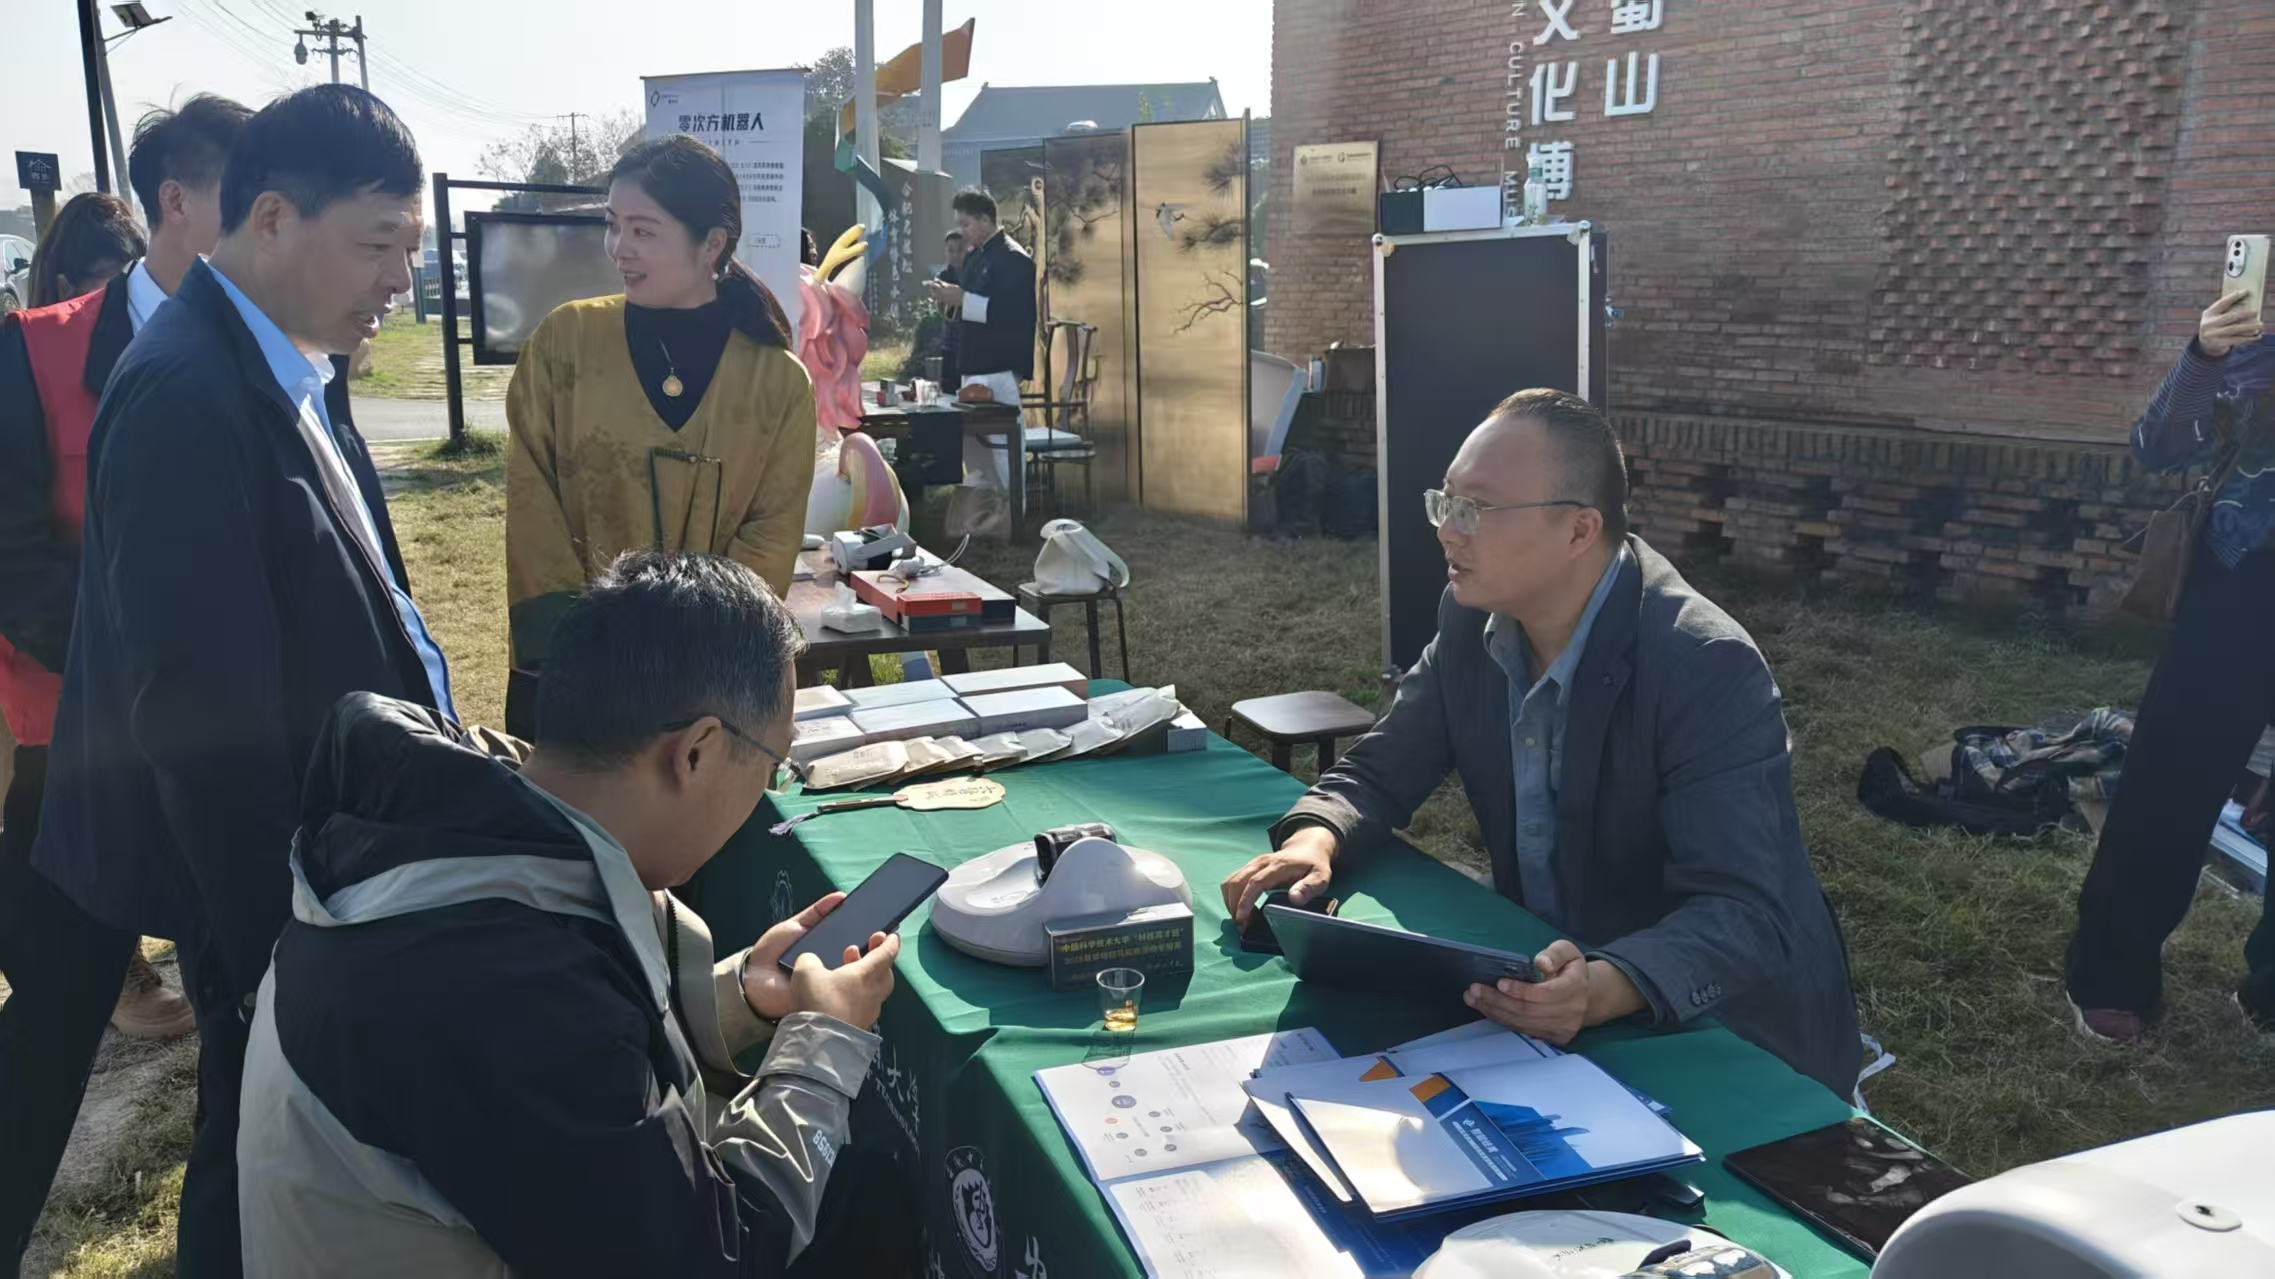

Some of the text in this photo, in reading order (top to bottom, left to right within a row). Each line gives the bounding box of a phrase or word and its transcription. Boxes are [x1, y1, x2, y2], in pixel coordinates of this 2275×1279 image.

[678, 112, 764, 133] 零次方机器人
[1505, 41, 1524, 149] CULTURE
